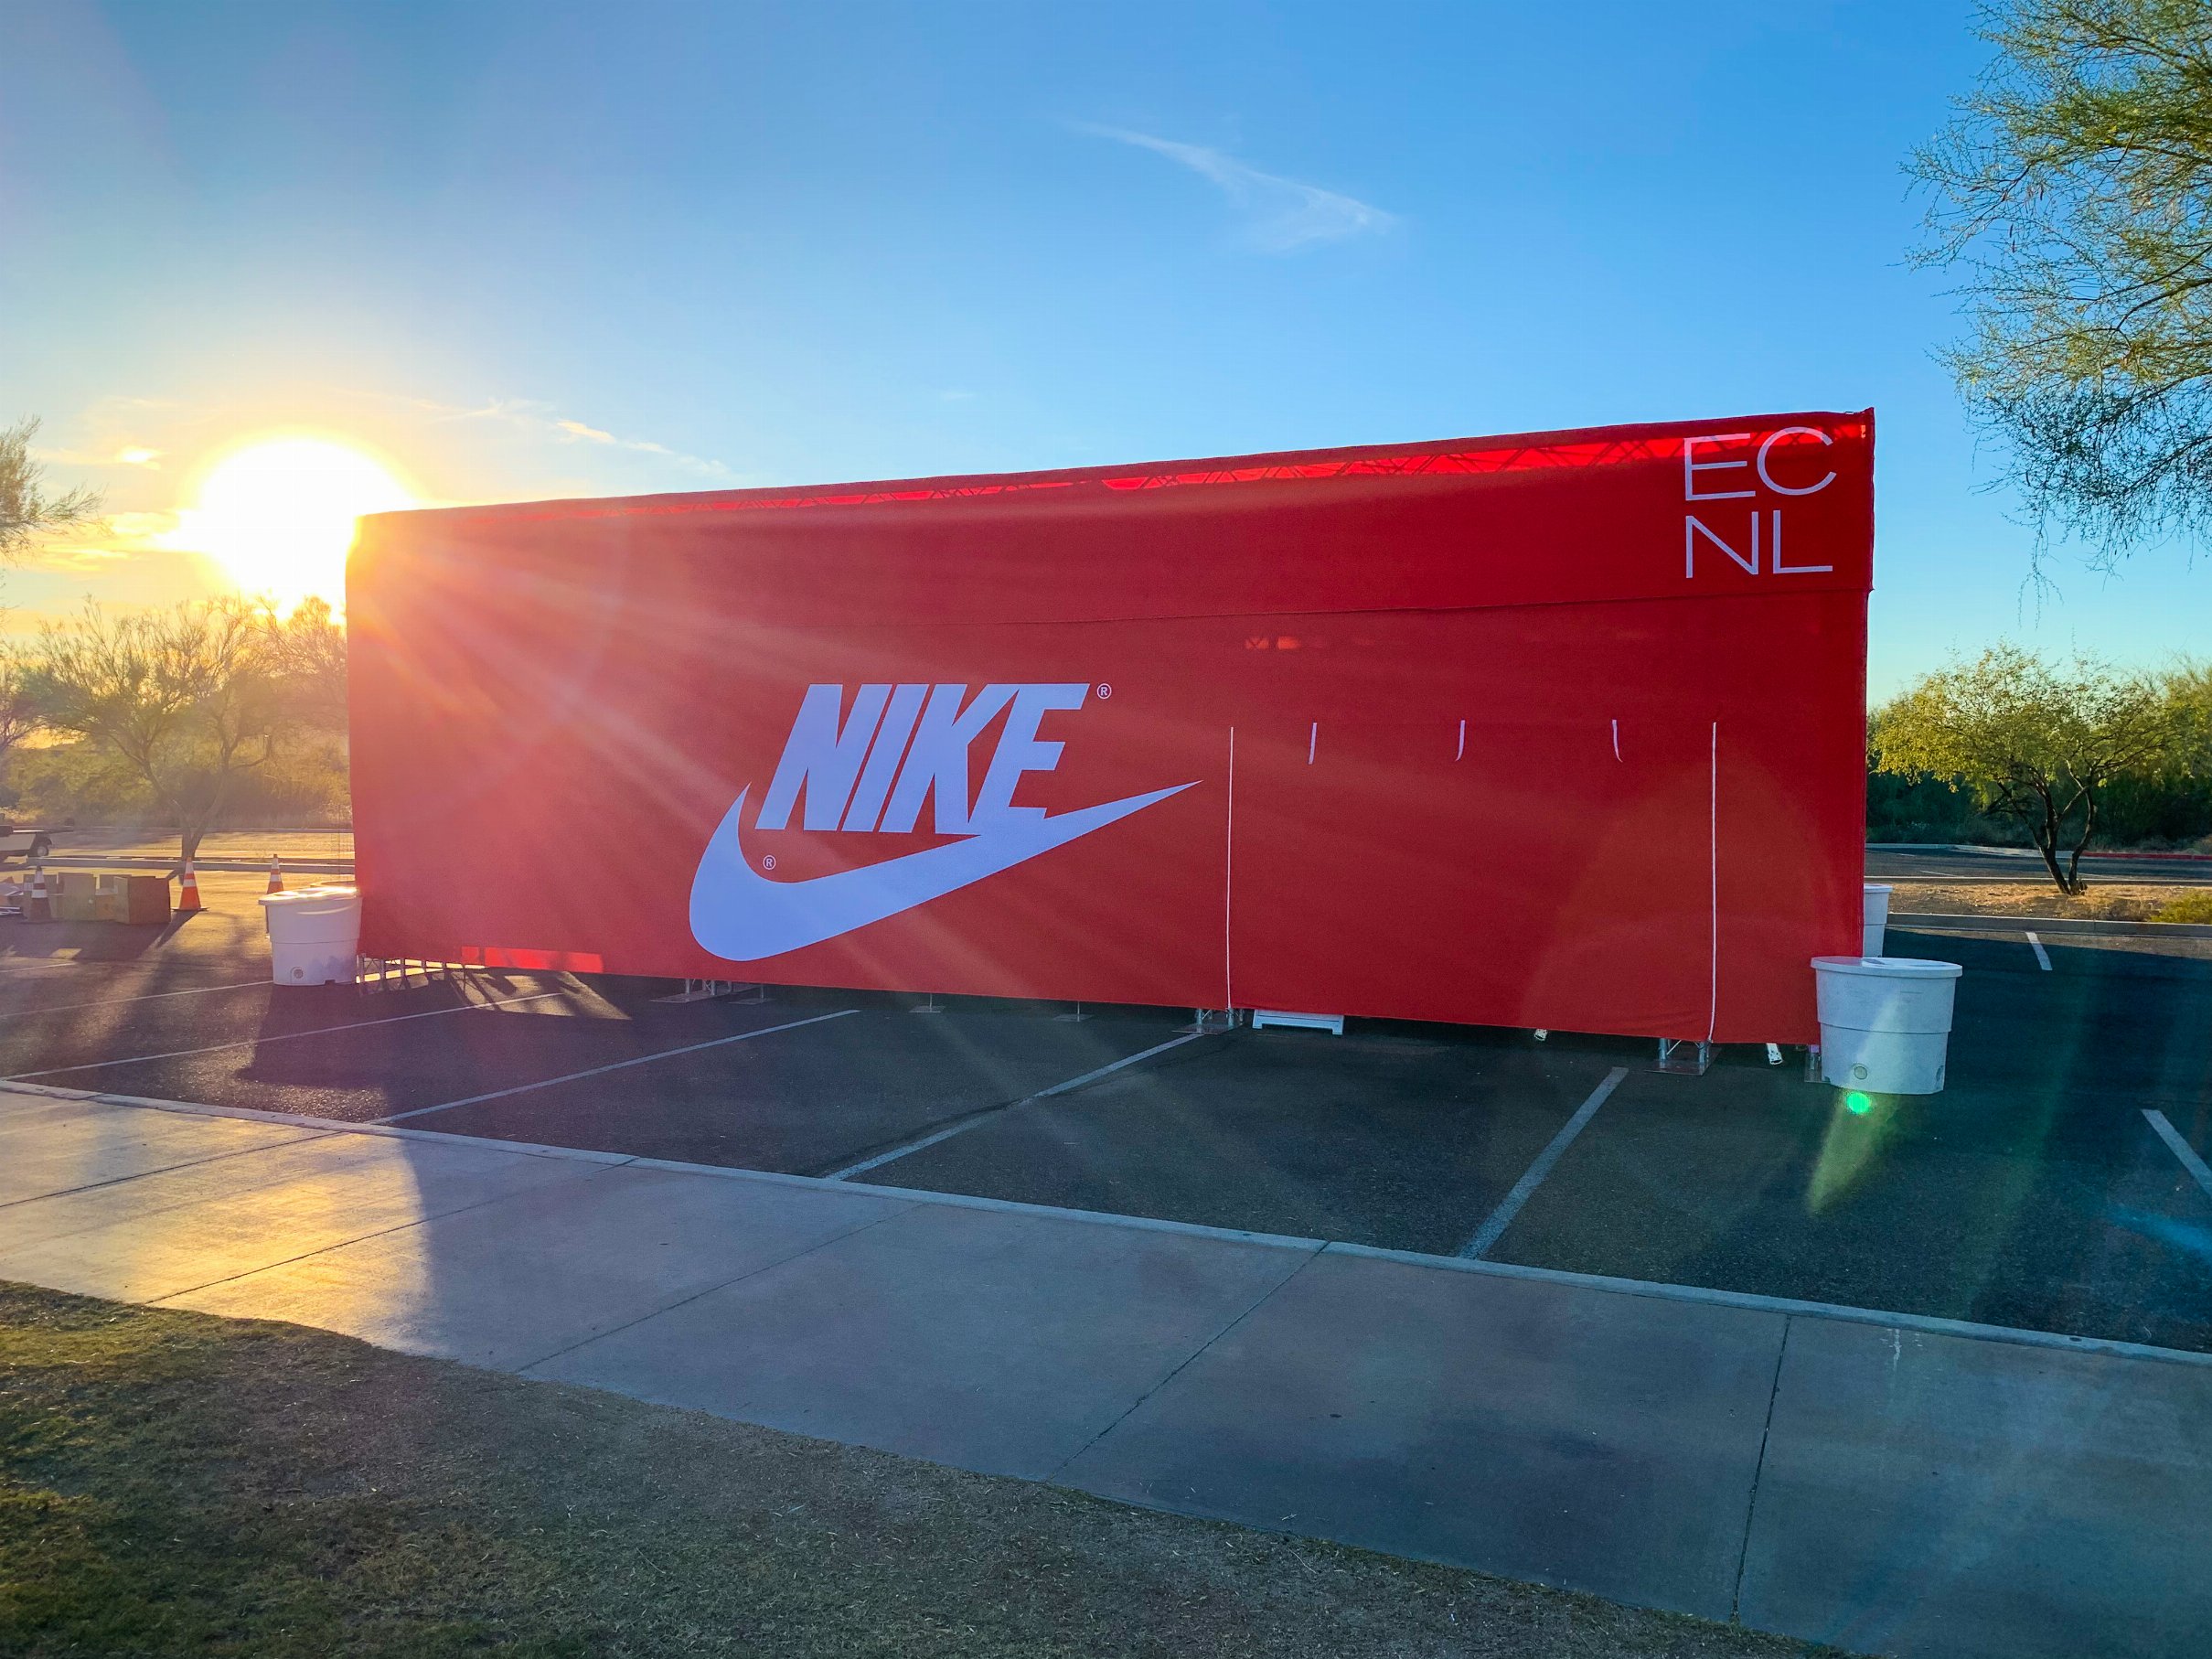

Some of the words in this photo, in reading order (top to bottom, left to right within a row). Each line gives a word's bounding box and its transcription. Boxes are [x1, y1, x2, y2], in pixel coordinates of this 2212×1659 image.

[1683, 426, 1837, 501] EC
[1685, 509, 1833, 578] NL
[754, 683, 1091, 835] NIKE
